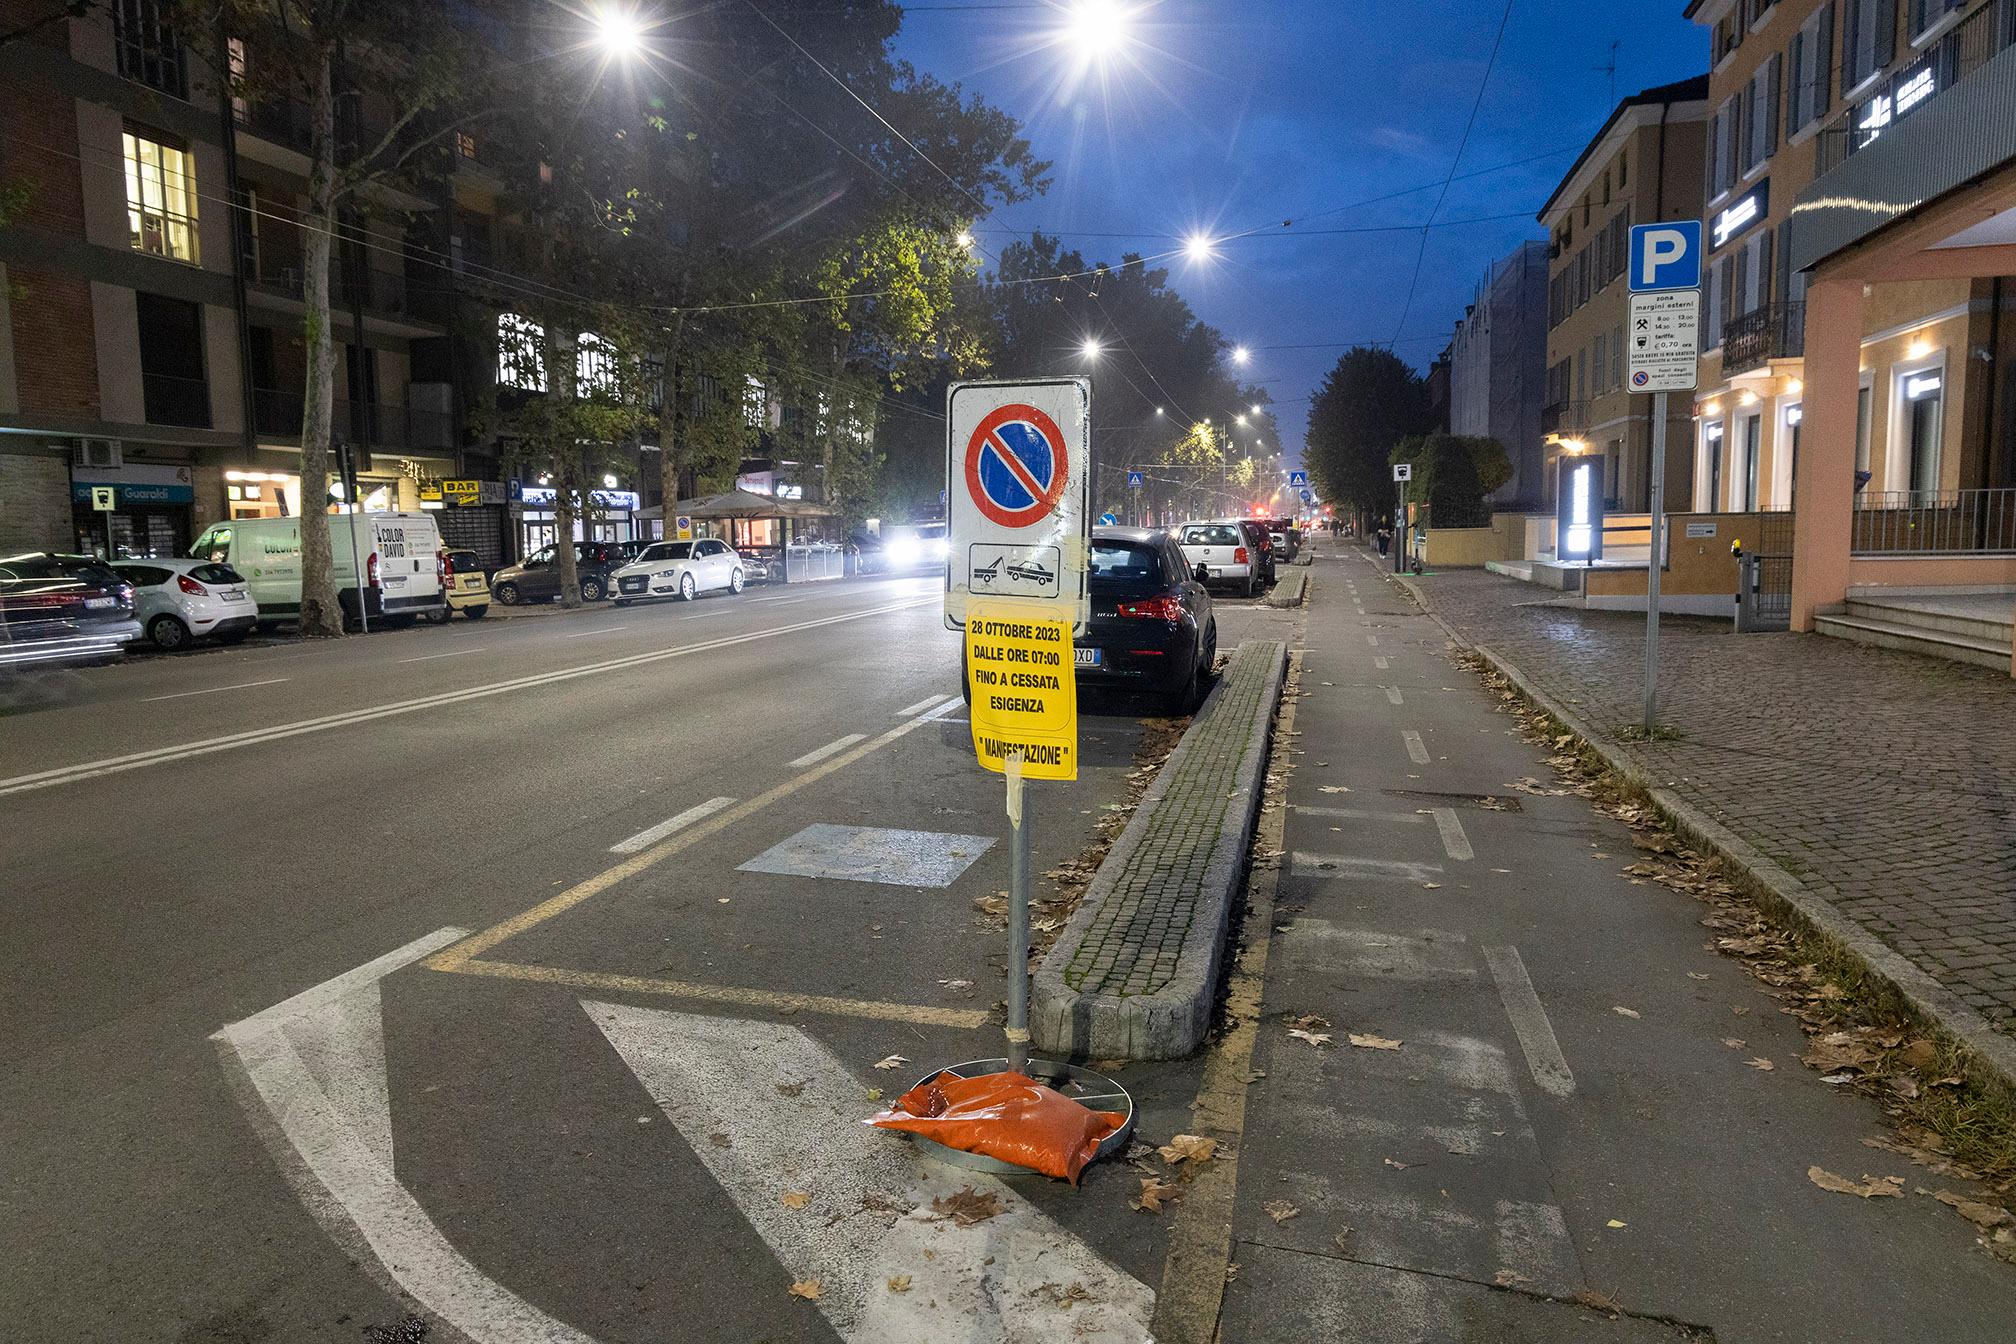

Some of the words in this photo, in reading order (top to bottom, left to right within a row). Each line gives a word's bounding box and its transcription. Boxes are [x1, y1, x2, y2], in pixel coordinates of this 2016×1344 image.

[1643, 229, 1687, 284] P
[1635, 303, 1665, 311] margini
[124, 487, 169, 499] Guaraldi
[446, 483, 476, 491] BAR
[382, 528, 405, 542] COLOR
[384, 544, 405, 558] DAVID
[971, 620, 983, 634] 28
[985, 621, 1033, 639] OTTOBRE
[1035, 627, 1060, 642] 2023
[974, 645, 1004, 661] DALLE
[1007, 648, 1029, 663] ORE
[1031, 650, 1060, 666] 07:00
[975, 669, 997, 685] FINO
[1000, 672, 1008, 686] A
[1011, 673, 1060, 690] CESSATA
[990, 696, 1045, 713] ESIGENZA
